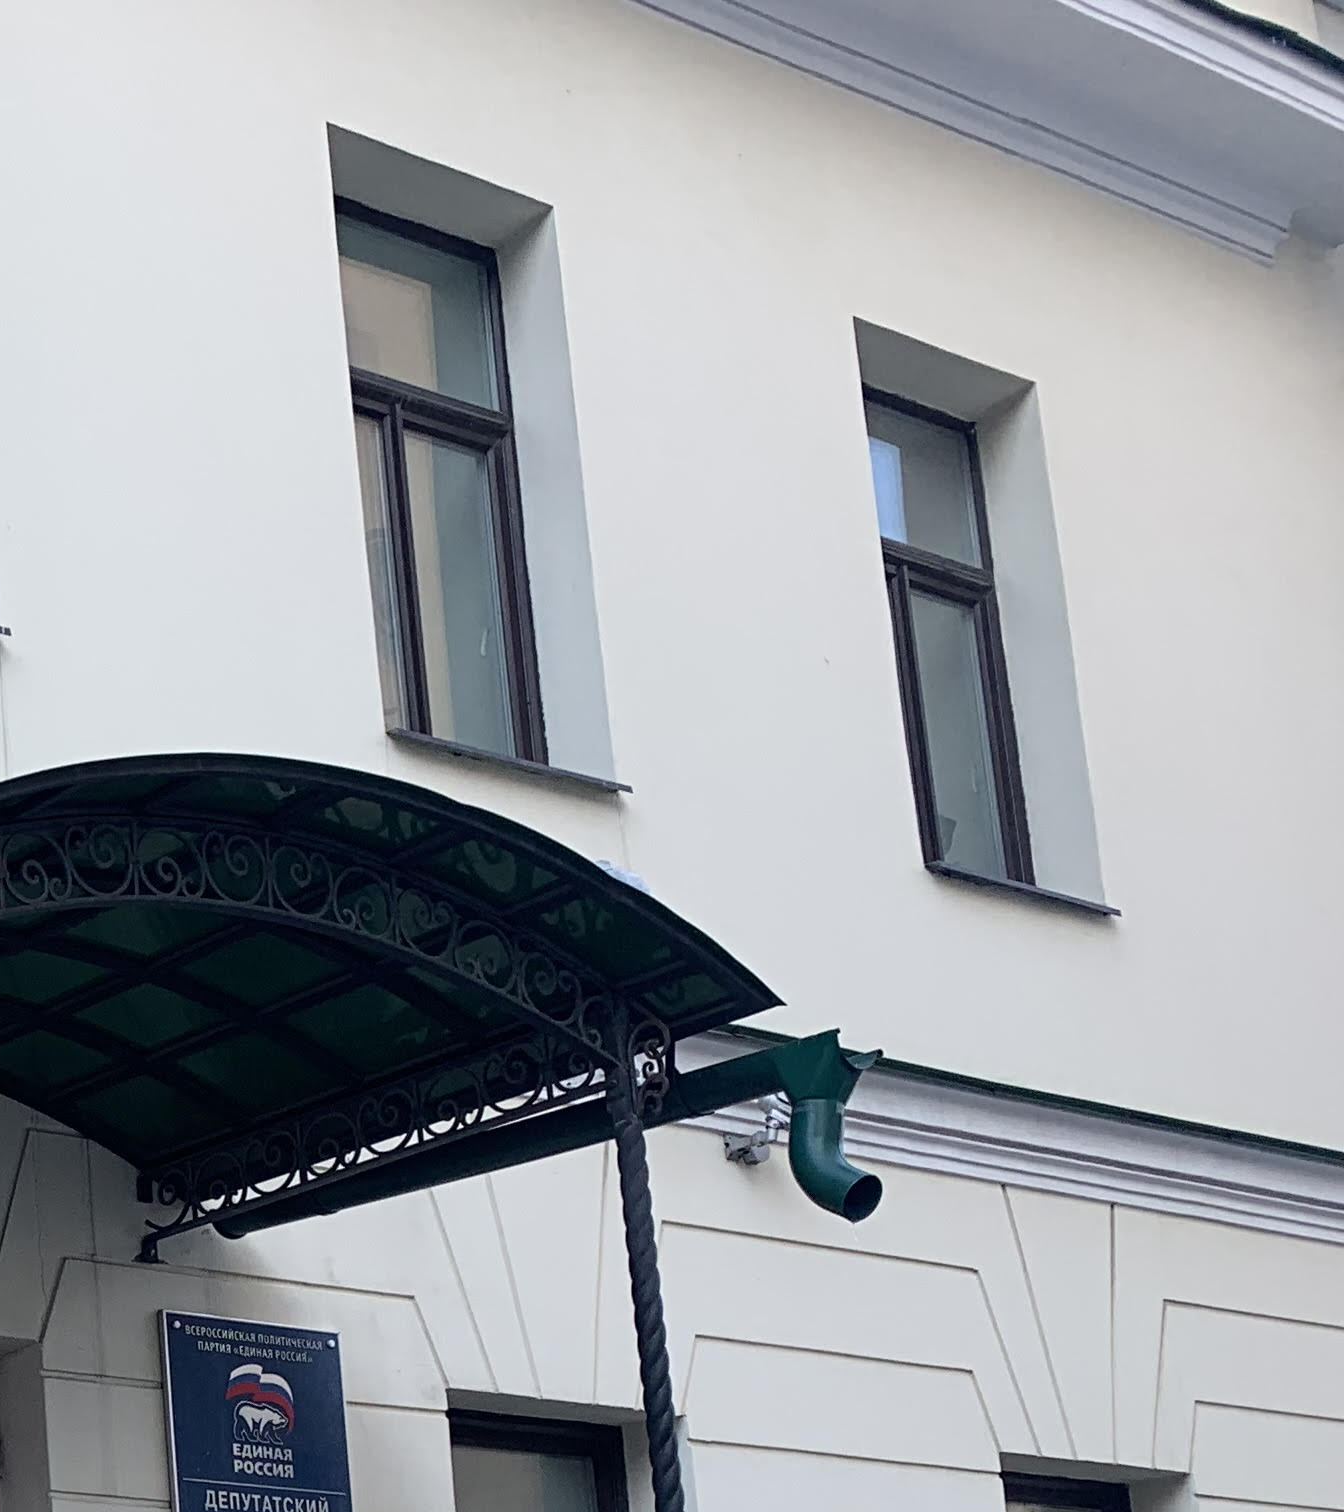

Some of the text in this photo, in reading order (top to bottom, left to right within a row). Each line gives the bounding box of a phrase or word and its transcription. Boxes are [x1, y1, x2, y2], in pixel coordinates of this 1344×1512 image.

[185, 1324, 323, 1351] ВСЕРОССИЙСКАЯ ПОЛИТИЧЕСКАЯ
[197, 1340, 232, 1354] ПАРТИЯ
[232, 1443, 293, 1461] ЕДИНАЯ
[234, 1459, 294, 1478] РОССИЯ
